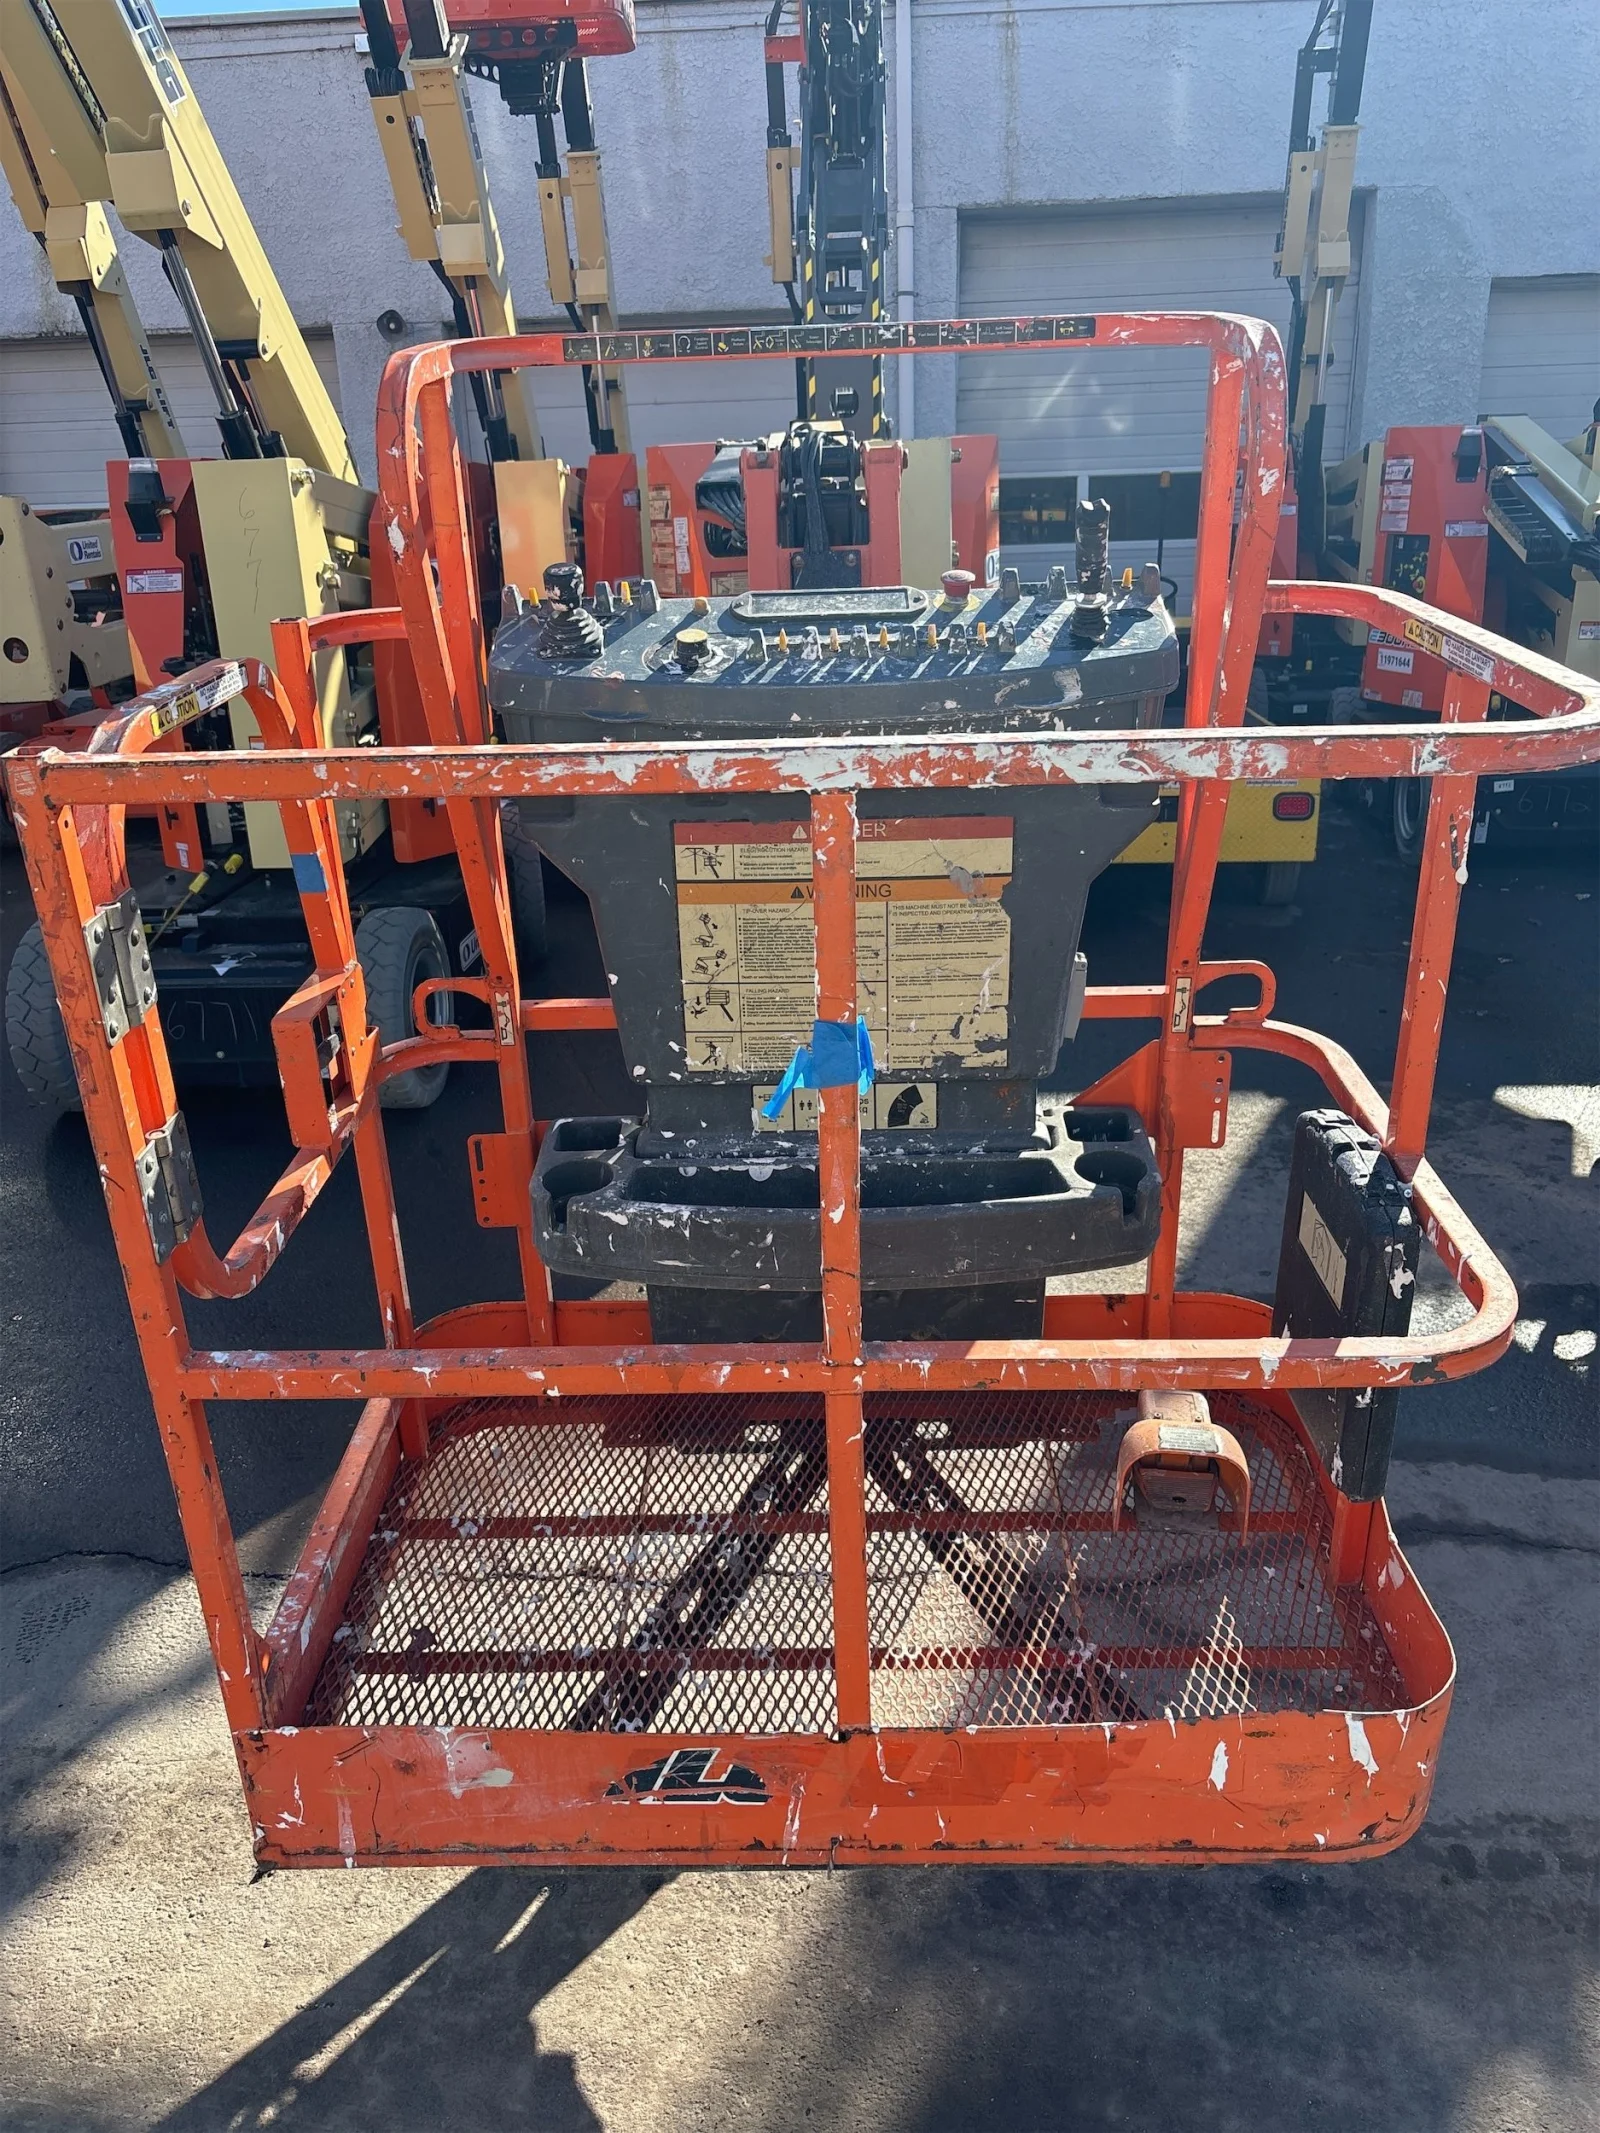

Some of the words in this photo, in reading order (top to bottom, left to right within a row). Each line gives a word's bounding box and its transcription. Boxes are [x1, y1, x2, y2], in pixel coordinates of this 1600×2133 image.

[82, 539, 98, 550] United
[84, 549, 102, 560] Rentals
[1414, 622, 1440, 649] CAUTION
[1452, 643, 1465, 654] HANDS
[1380, 654, 1410, 668] 11971644
[167, 1000, 258, 1044] 6771
